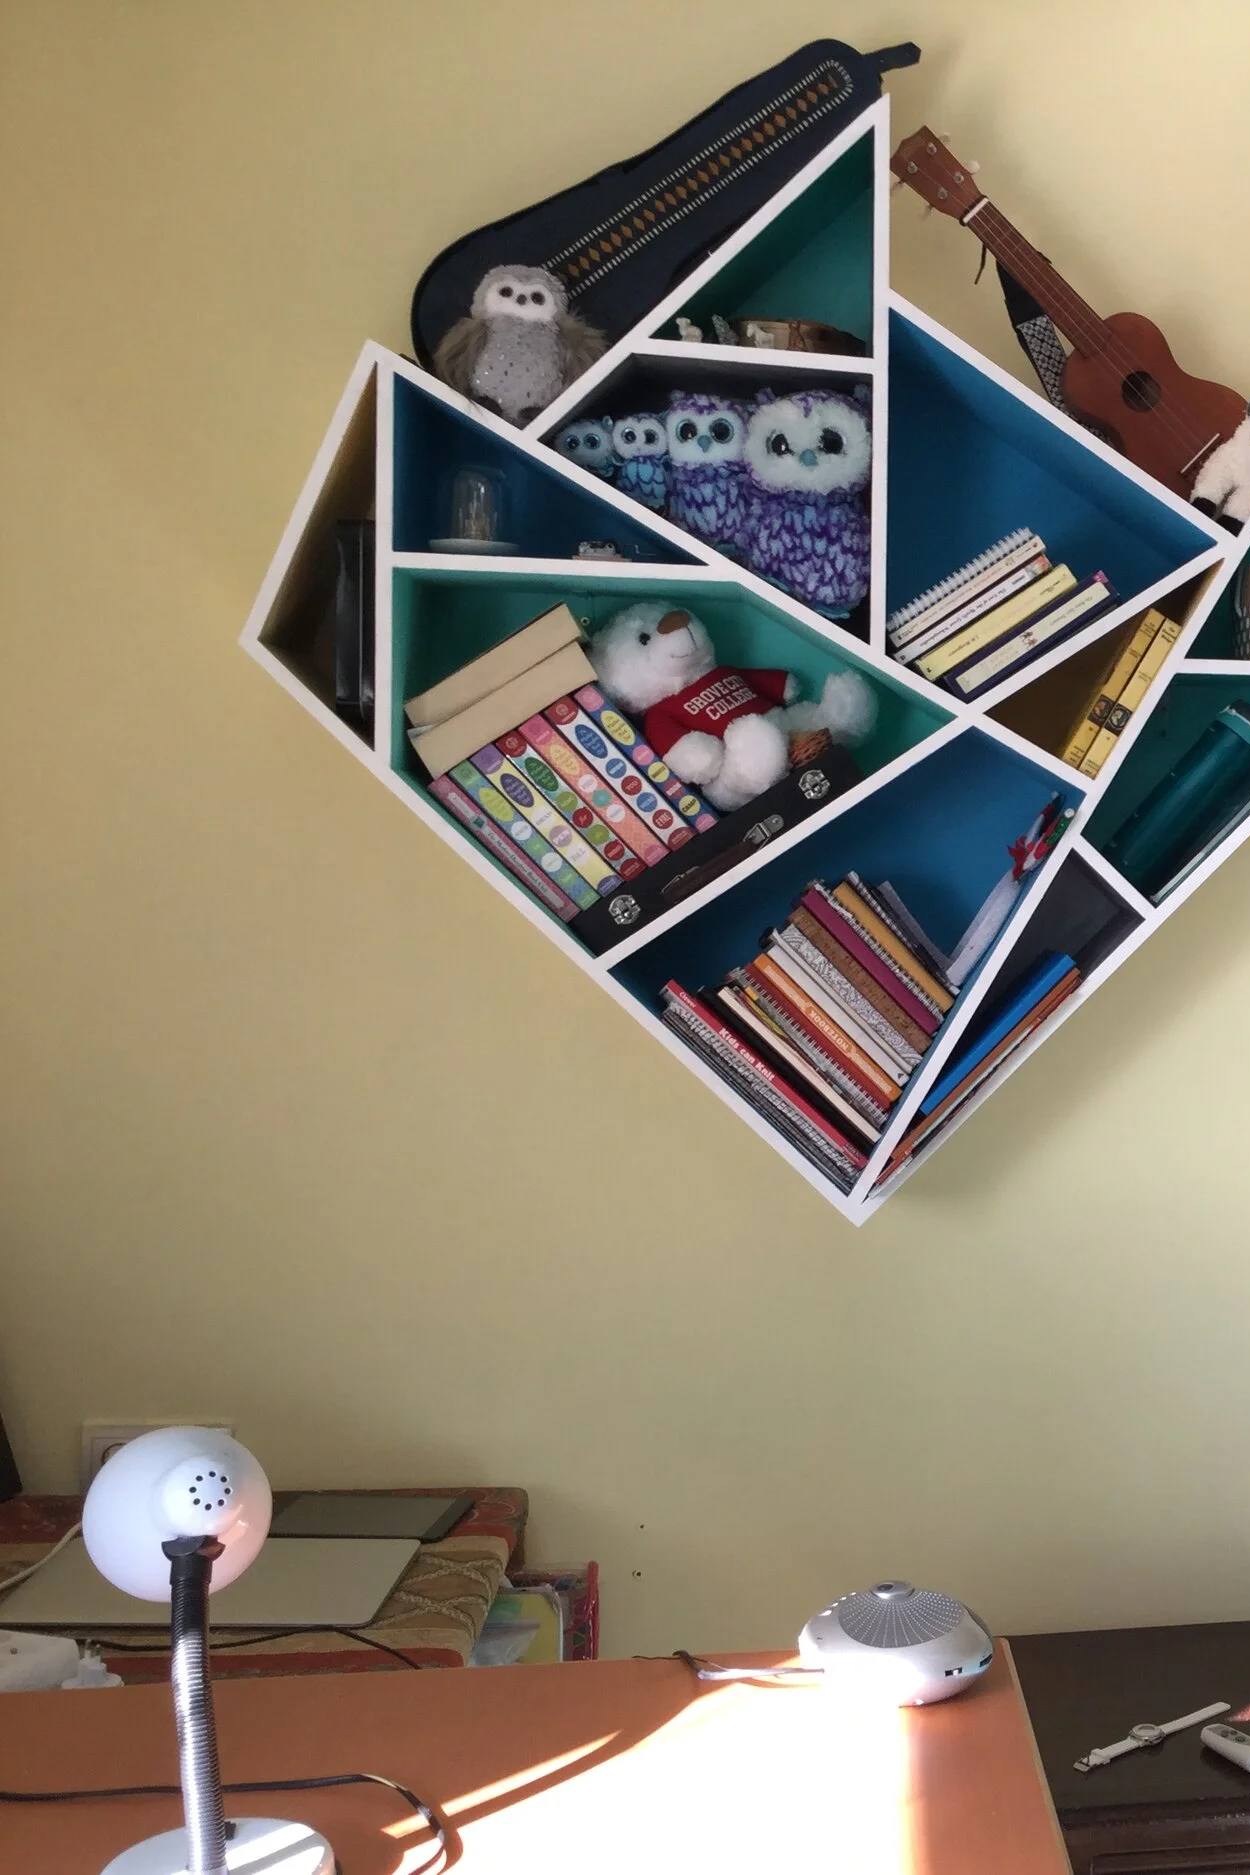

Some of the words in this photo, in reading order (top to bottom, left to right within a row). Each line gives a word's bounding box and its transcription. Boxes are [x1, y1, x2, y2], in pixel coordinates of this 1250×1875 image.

[683, 682, 729, 715] GROVE
[705, 687, 757, 720] COLLEGE
[682, 798, 698, 813] CAMP
[809, 1010, 849, 1051] NOTEBOOK
[719, 1027, 740, 1050] Kids
[740, 1048, 757, 1065] can
[755, 1062, 776, 1081] Knit
